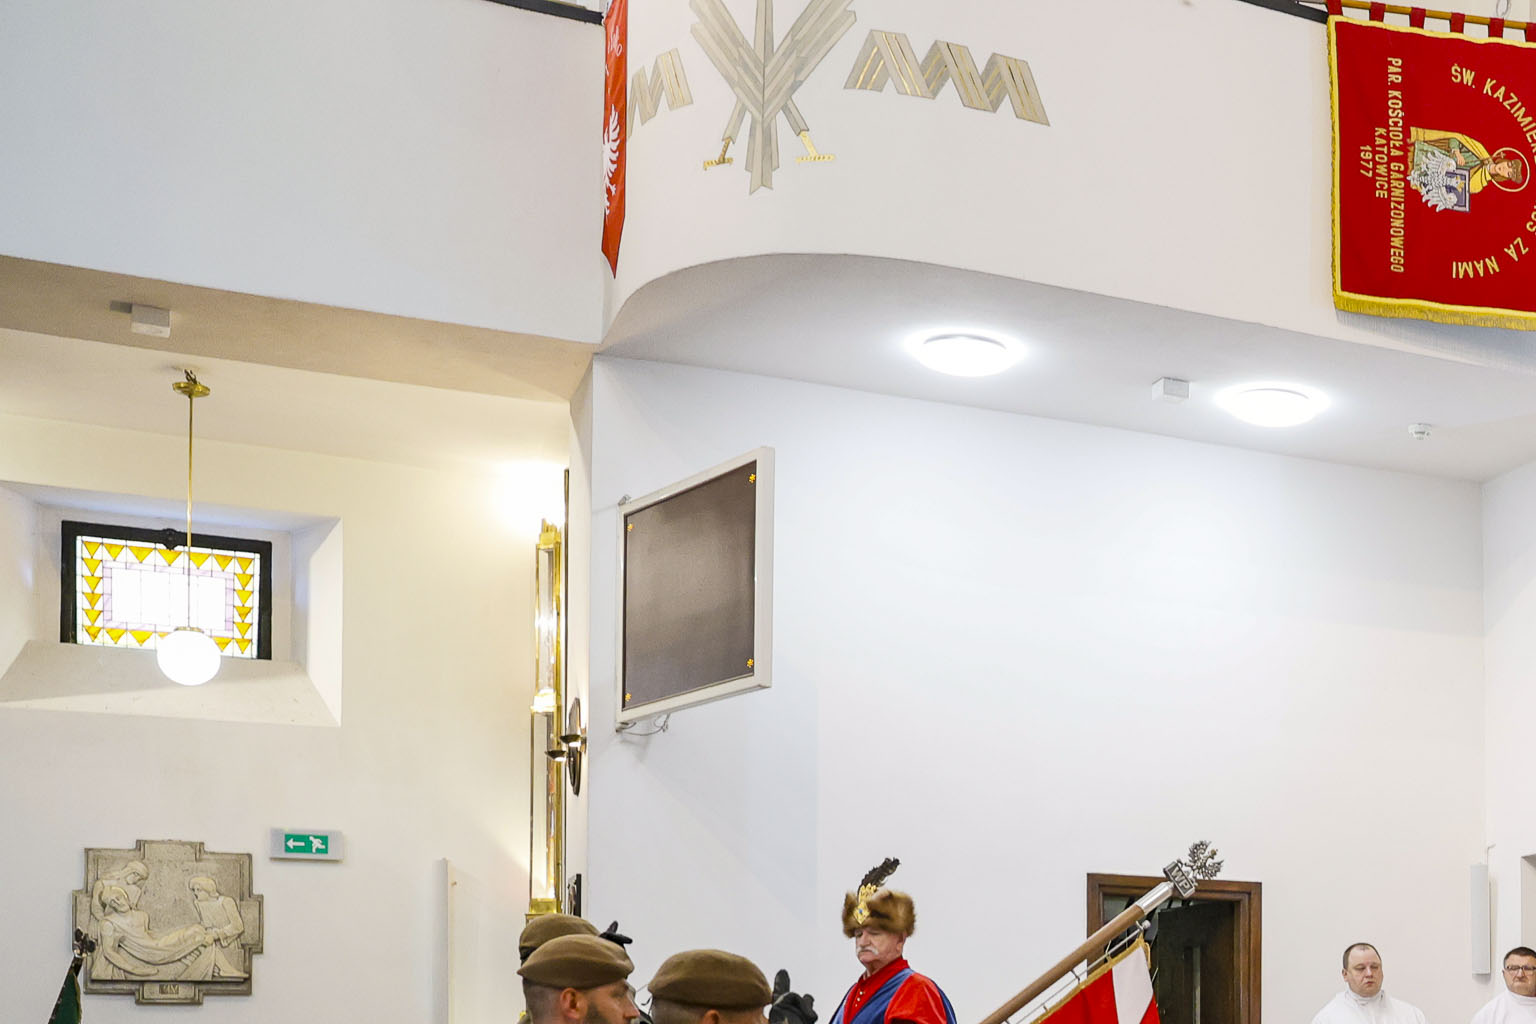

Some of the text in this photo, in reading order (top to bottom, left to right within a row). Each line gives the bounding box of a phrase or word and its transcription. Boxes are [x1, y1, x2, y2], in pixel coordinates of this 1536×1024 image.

[1451, 63, 1475, 88] ŚW.
[1359, 145, 1373, 178] 1977
[1374, 127, 1387, 199] KATOWICE
[1387, 57, 1405, 273] PAR. KOŚCIOŁA GARNIZONOWEGO
[1504, 237, 1529, 262] ZA
[1452, 256, 1500, 279] NAMI
